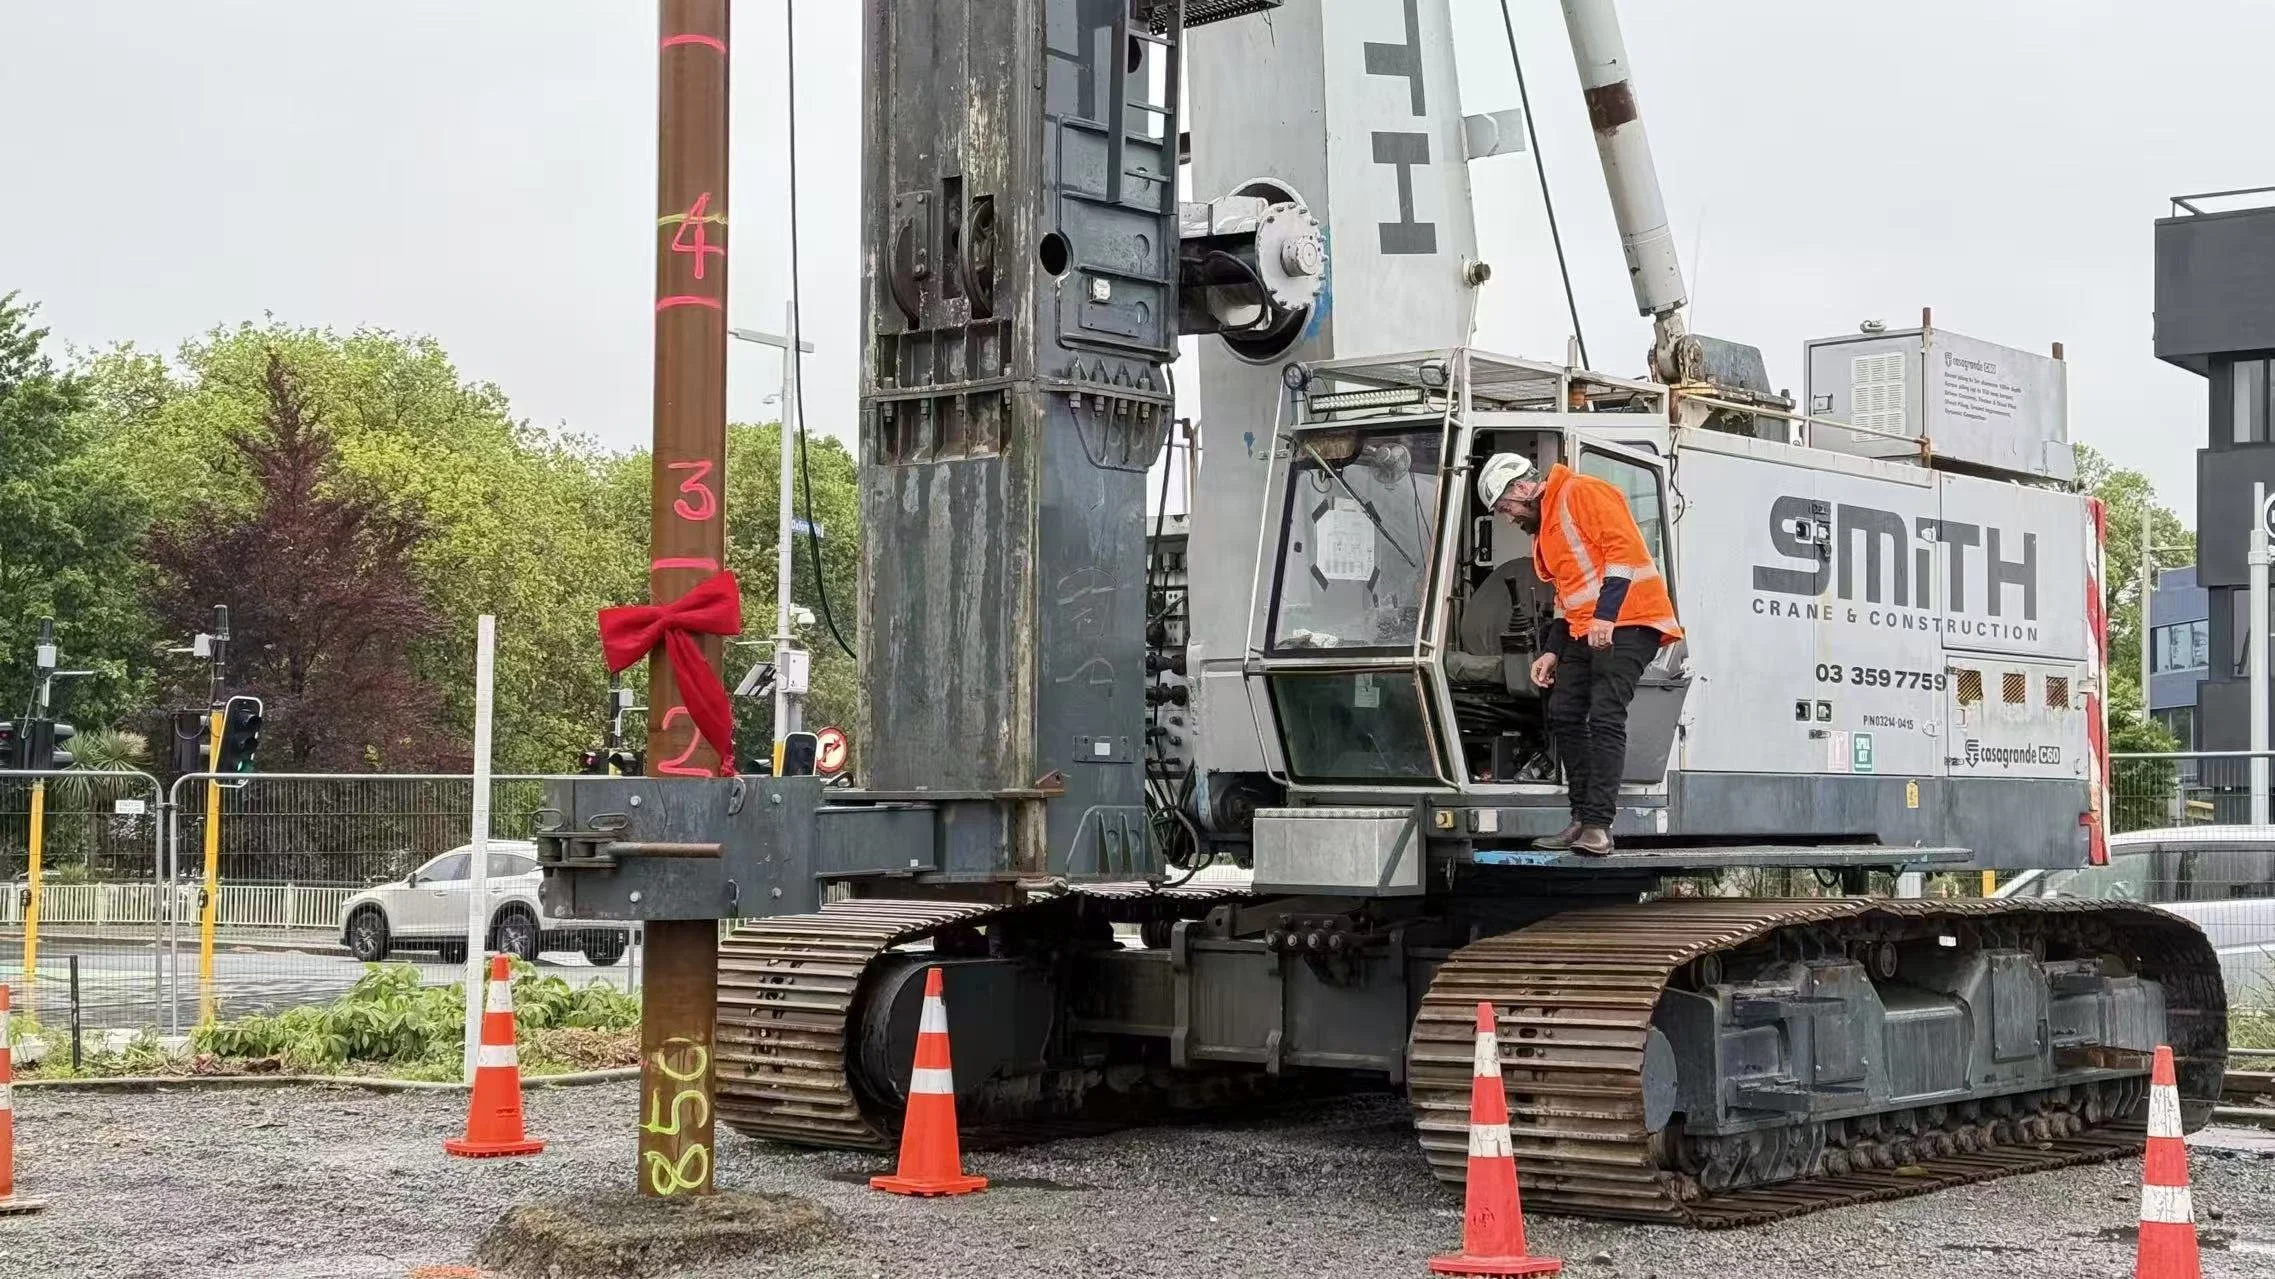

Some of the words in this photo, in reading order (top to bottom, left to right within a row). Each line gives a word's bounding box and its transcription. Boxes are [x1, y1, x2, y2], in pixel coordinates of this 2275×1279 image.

[672, 192, 725, 279] 4
[668, 461, 716, 520] 3
[1752, 598, 1833, 621] CRANE
[1847, 609, 1857, 623] &
[1869, 611, 2038, 641] CONSTRUCTION
[1816, 663, 1843, 683] 03
[1981, 742, 2037, 769] casagrande
[2040, 747, 2060, 764] C60
[642, 1037, 709, 1196] 850
